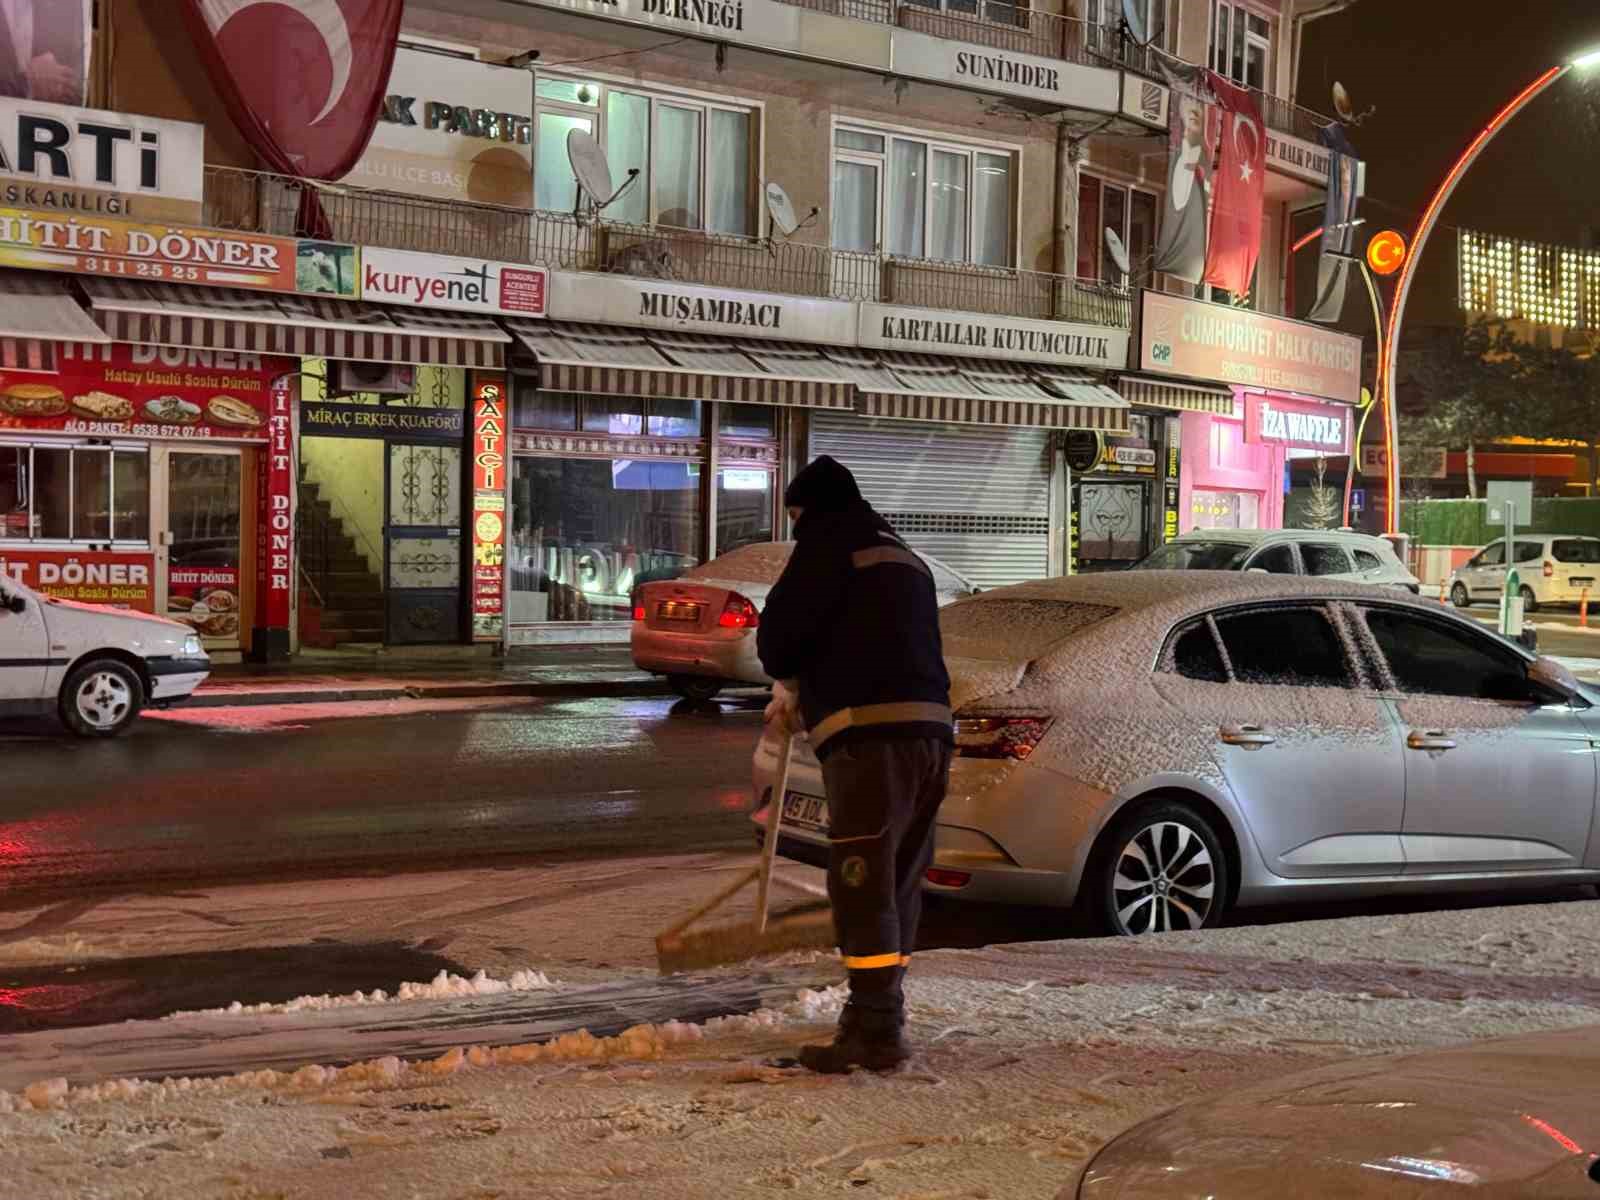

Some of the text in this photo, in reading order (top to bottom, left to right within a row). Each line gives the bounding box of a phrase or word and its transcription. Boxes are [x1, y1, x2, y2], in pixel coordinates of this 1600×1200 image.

[956, 51, 1060, 92] SUNİMDER
[127, 229, 280, 269] DÖNER
[85, 257, 199, 280] 311 25 25
[365, 264, 489, 303] kuryenet
[639, 291, 783, 328] MUŞAMBACI
[881, 316, 1109, 360] KARTALLAR KUYUMCULUK
[307, 407, 352, 427] MİRAÇ
[354, 412, 399, 429] ERKEK
[1286, 411, 1342, 444] WAFFLE
[271, 494, 289, 590] DÖNER
[39, 558, 149, 585] DÖNER
